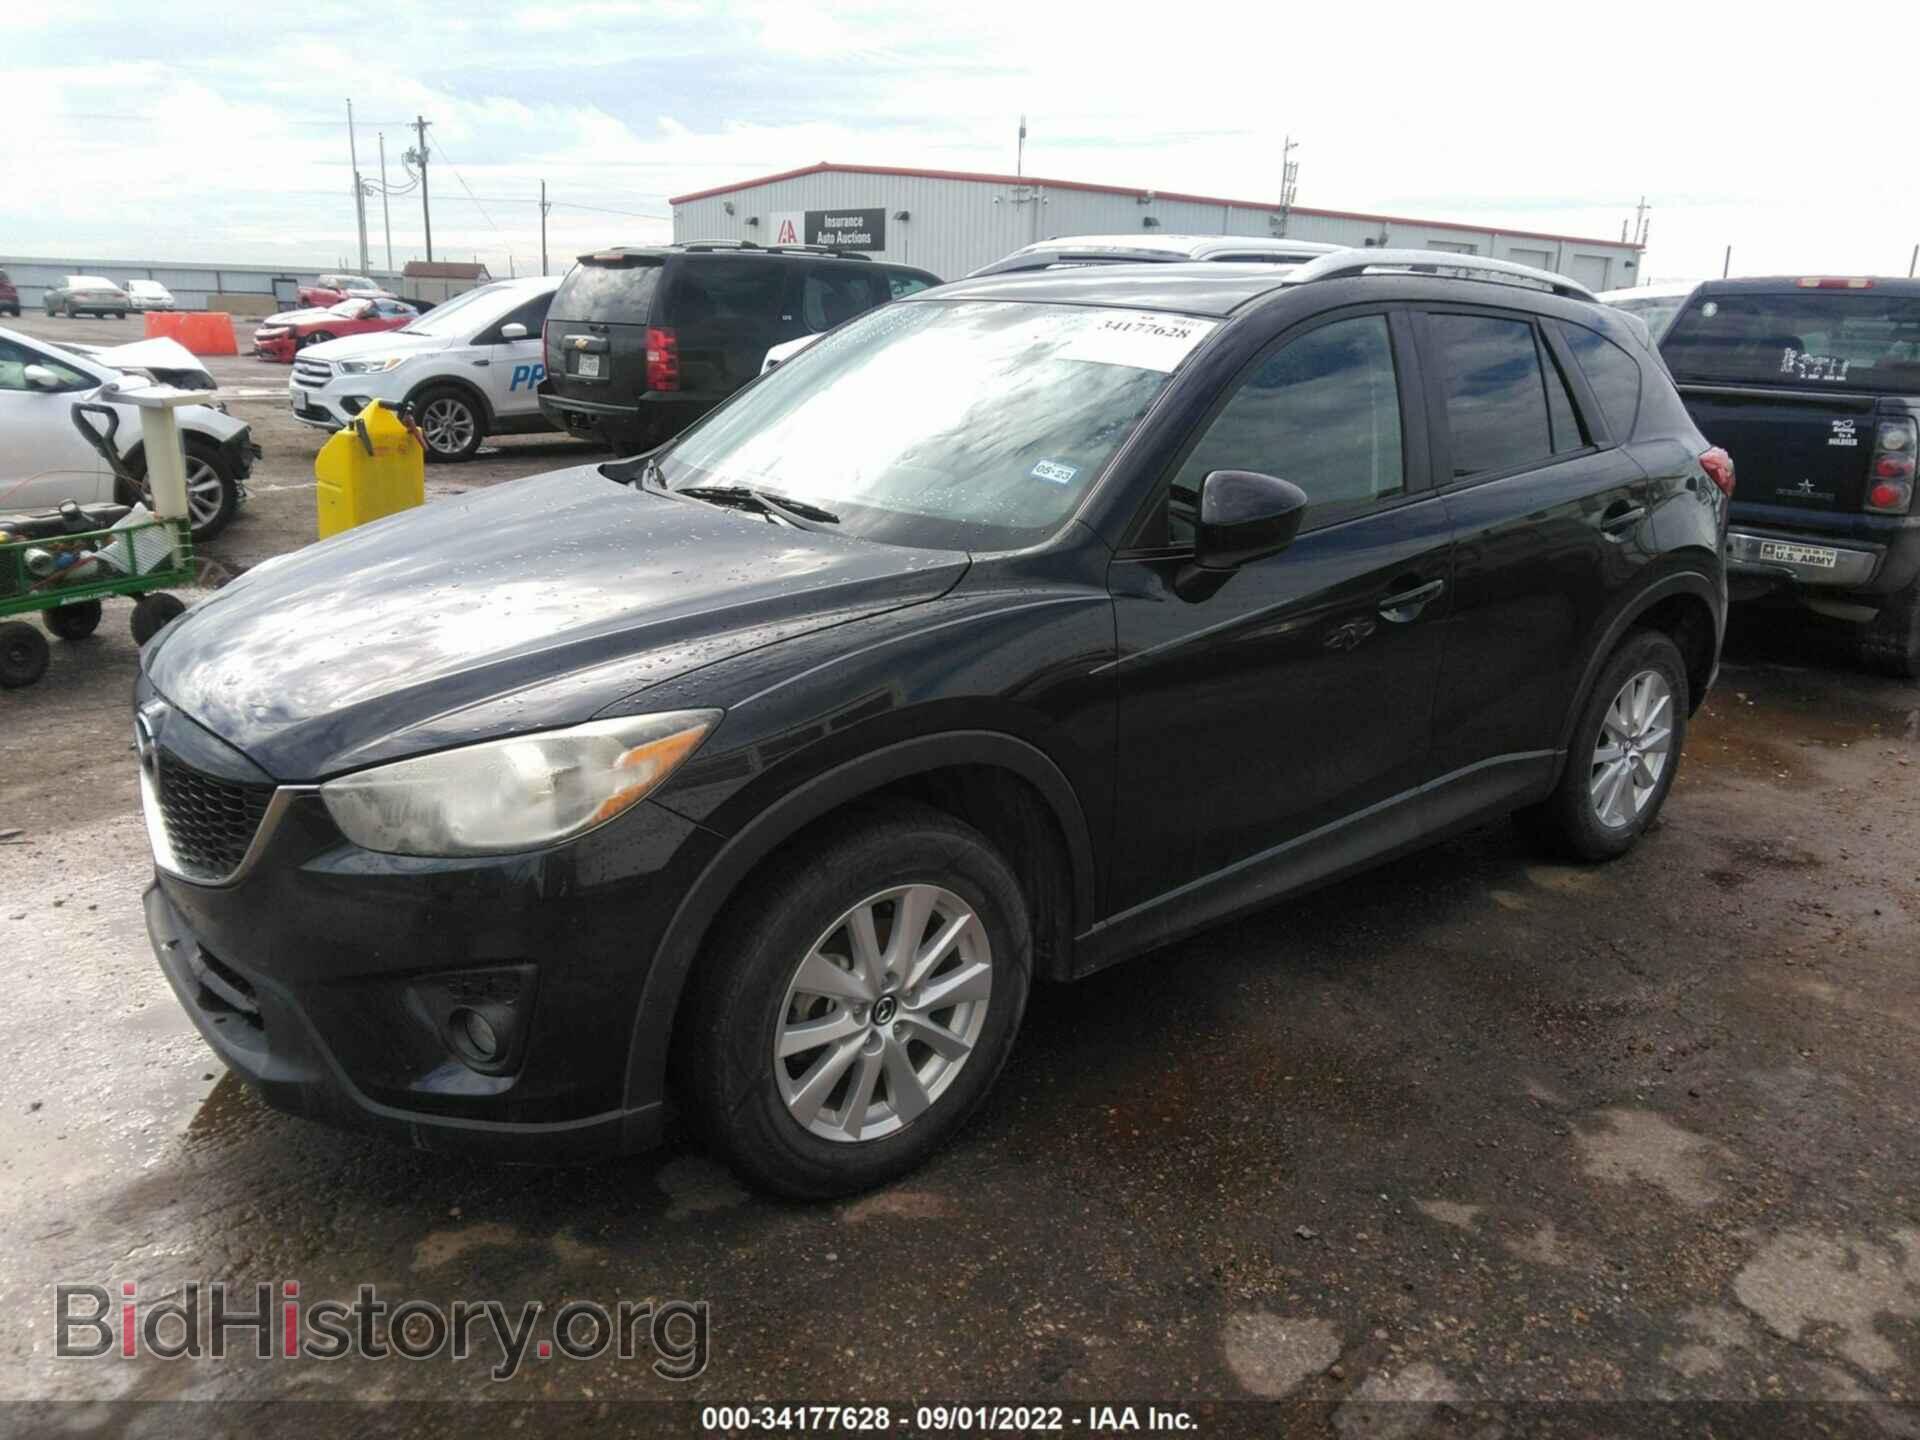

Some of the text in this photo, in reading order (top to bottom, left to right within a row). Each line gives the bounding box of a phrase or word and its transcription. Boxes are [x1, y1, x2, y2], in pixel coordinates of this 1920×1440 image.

[824, 214, 864, 228] Insurance
[817, 230, 872, 245] Auto Auctions
[1776, 551, 1797, 561] U.S.
[1800, 554, 1833, 566] ARMY
